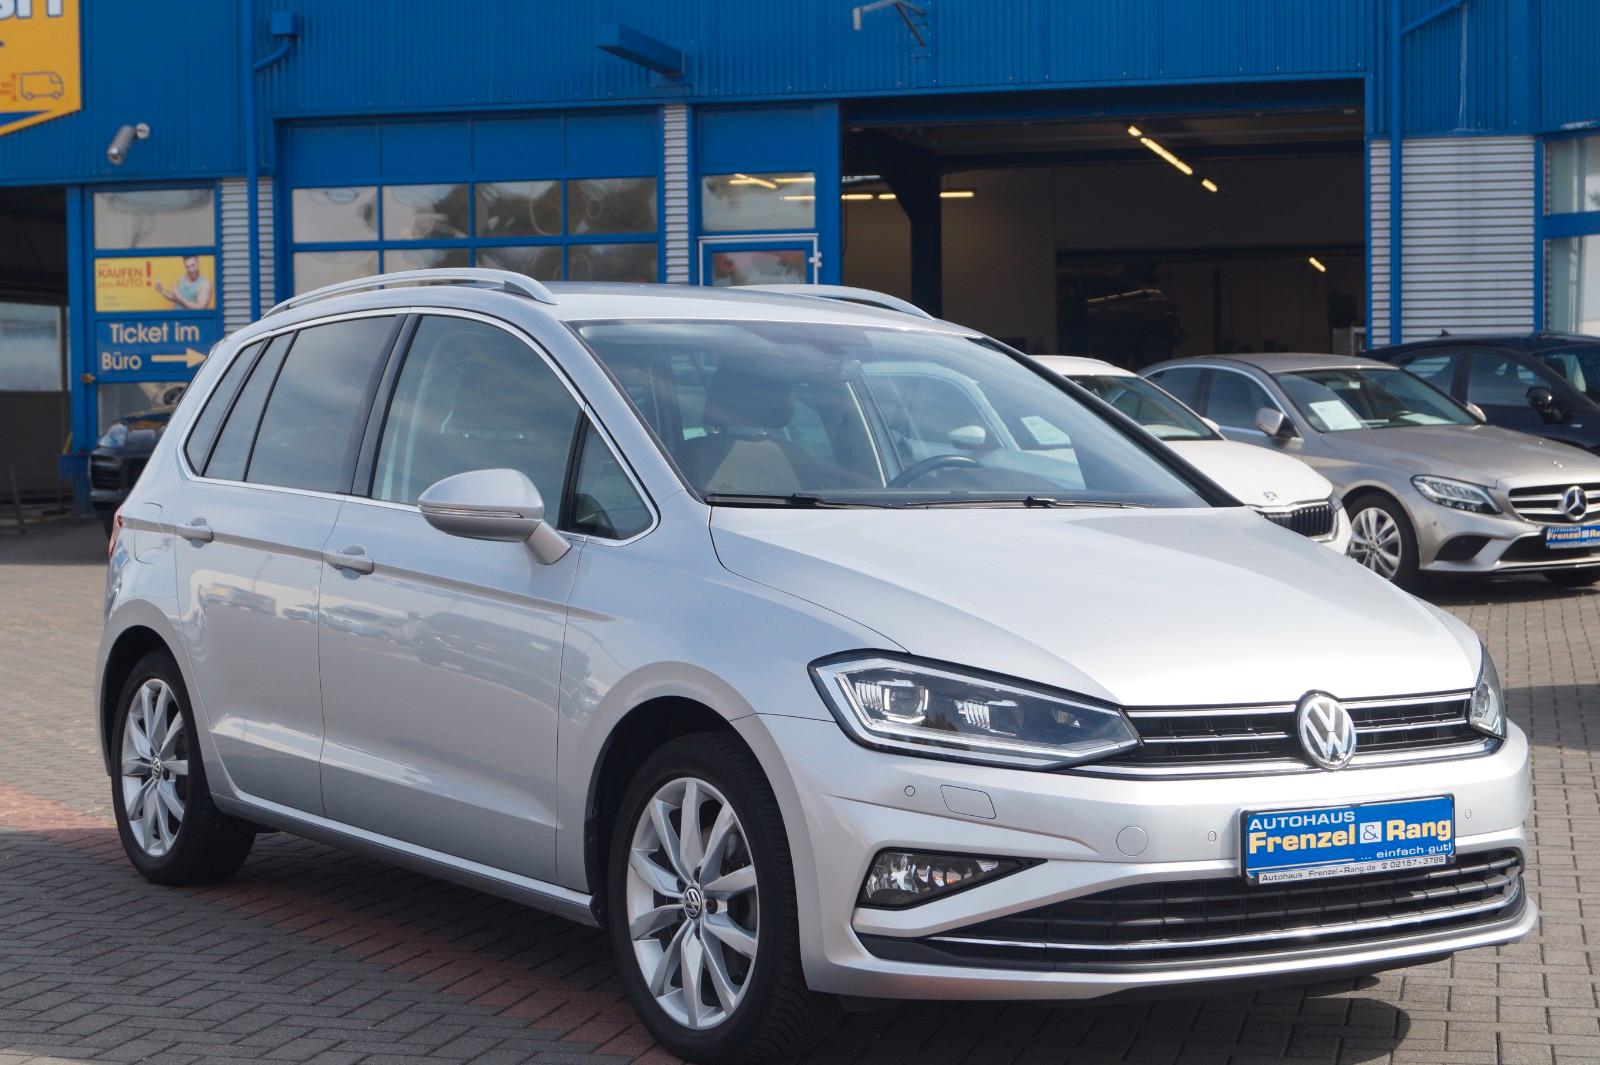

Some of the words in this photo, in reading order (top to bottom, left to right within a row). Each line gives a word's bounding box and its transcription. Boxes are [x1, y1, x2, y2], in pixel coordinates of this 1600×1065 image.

[98, 268, 143, 278] KAUFEN
[115, 278, 143, 288] AUTO
[109, 323, 168, 343] Ticket
[175, 323, 200, 341] im
[101, 351, 142, 371] Büro
[1547, 529, 1581, 541] Frenzel
[1249, 811, 1356, 831] AUTOHAUS
[1249, 824, 1356, 854] Frenzel
[1362, 824, 1379, 841] &
[1386, 818, 1451, 841] Rang
[1376, 846, 1424, 859] einfach
[1262, 873, 1303, 882] Autohaus
